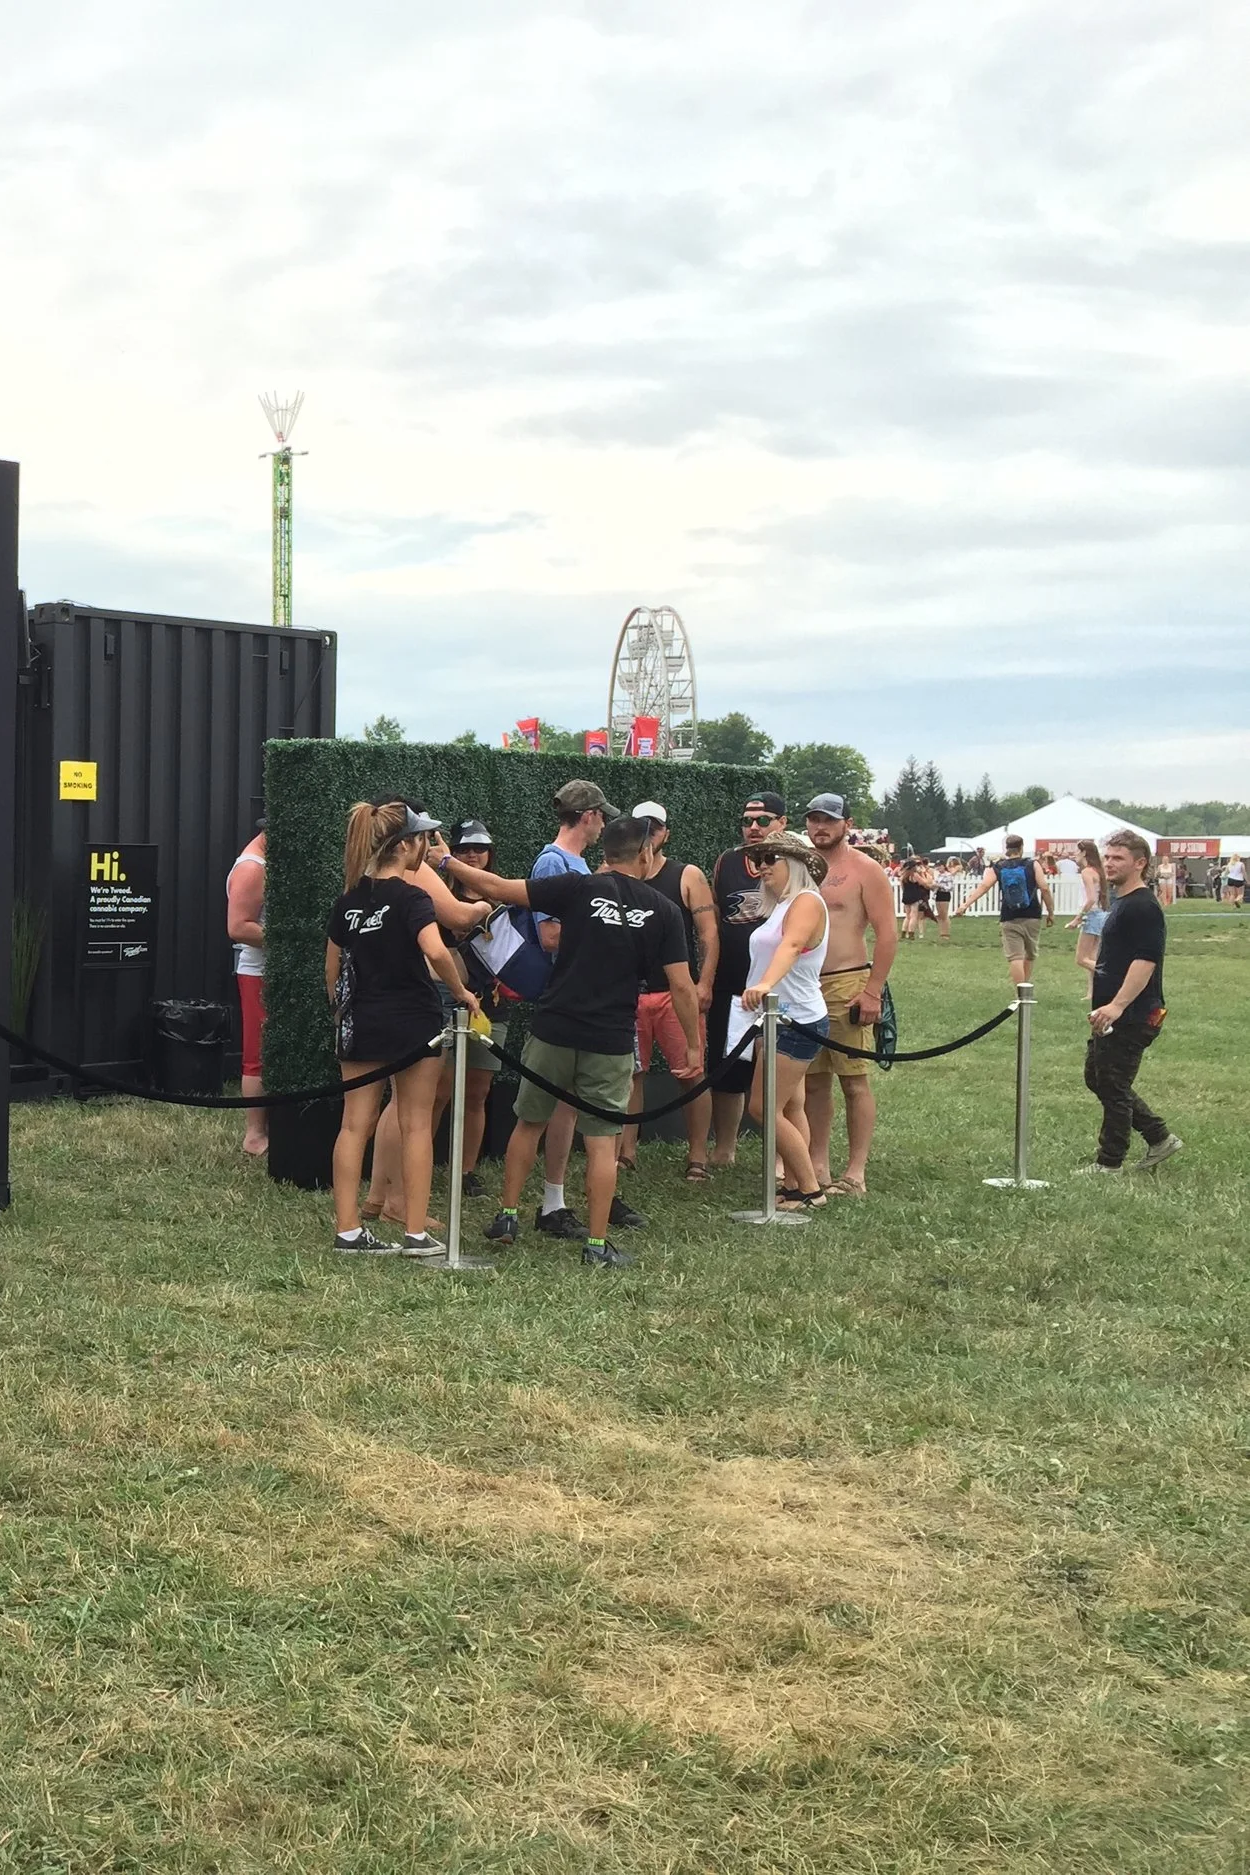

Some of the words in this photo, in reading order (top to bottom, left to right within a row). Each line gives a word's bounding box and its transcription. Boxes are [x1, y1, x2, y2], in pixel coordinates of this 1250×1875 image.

[90, 851, 127, 882] Hi.
[90, 886, 110, 894] We're
[110, 886, 132, 894] Tweed.
[90, 895, 96, 903] A
[96, 895, 120, 905] proudly
[121, 895, 152, 903] Canadian
[89, 904, 118, 912] cannabis
[118, 906, 148, 914] company.
